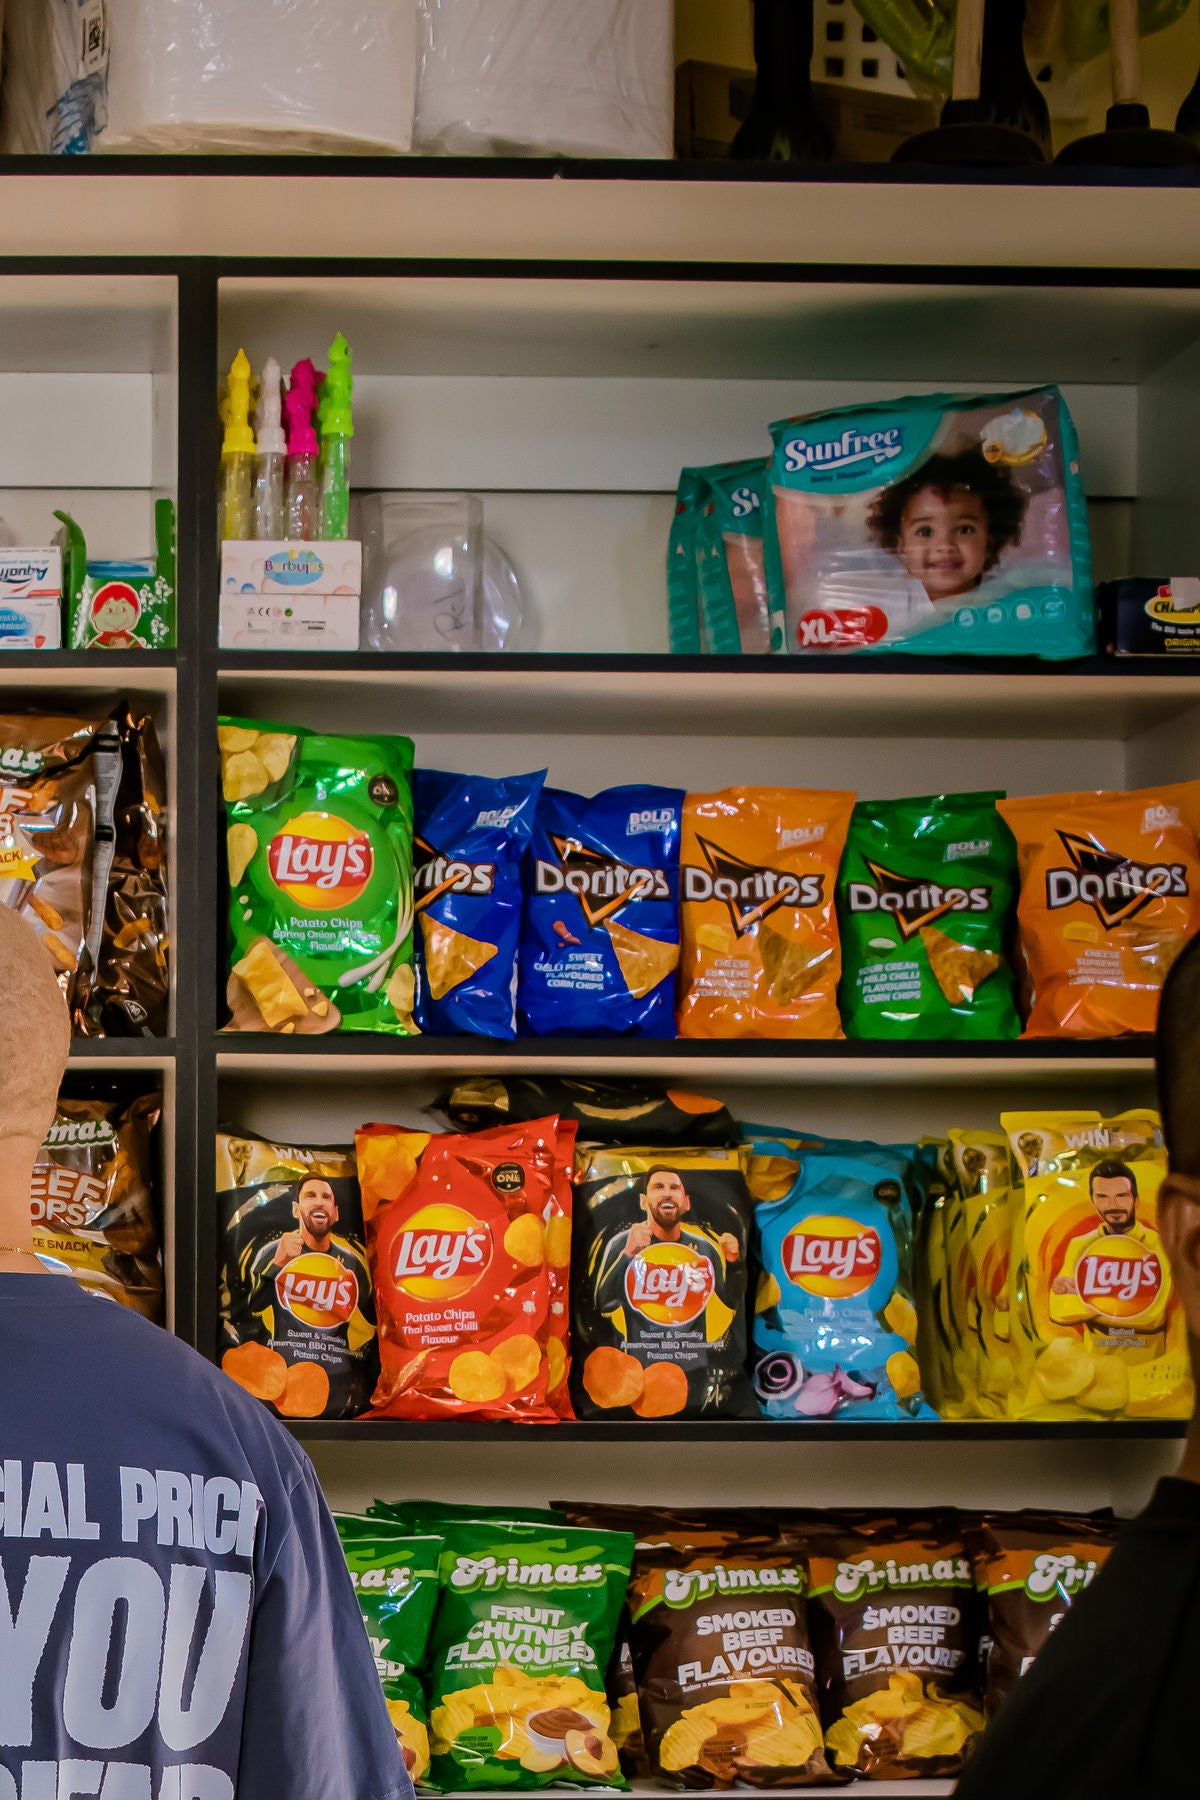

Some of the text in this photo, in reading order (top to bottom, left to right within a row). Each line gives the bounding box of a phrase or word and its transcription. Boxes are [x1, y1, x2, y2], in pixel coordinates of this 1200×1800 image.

[784, 426, 904, 472] Sunfree
[799, 617, 832, 647] XL
[629, 809, 674, 825] BOLD
[275, 834, 368, 890] Lay's
[536, 859, 670, 898] Doritos
[684, 866, 821, 905] Doritos
[1050, 864, 1188, 907] Doritos
[850, 883, 989, 911] Doritos
[290, 916, 364, 930] Potato Chips
[568, 953, 603, 962] SWEET
[1064, 1129, 1110, 1148] WIN
[47, 1239, 91, 1252] SNACK
[394, 1227, 486, 1280] Lay's
[790, 1231, 877, 1280] Lay's
[632, 1257, 708, 1307] Lay's
[1082, 1255, 1160, 1301] Lay's
[285, 1272, 353, 1312] Lay's
[402, 1320, 479, 1335] Thai Sweet Chilli
[405, 1309, 476, 1323] Potato Chips
[421, 1333, 459, 1346] Flavour
[620, 1340, 661, 1350] American
[640, 1330, 662, 1340] Sweet
[673, 1330, 704, 1342] Smoky
[647, 1350, 699, 1362] Potato Chips
[450, 1555, 604, 1588] Frimax
[664, 1564, 801, 1602] Frimax
[834, 1557, 971, 1595] Frimax
[490, 1604, 566, 1626] FRUIT
[696, 1608, 796, 1636] SMOKED
[862, 1605, 960, 1631] SMOKED
[466, 1621, 589, 1646] CHUTNEY
[722, 1628, 784, 1652] BEEF
[887, 1624, 945, 1645] BEEF
[446, 1640, 596, 1666] FLAVOURED
[677, 1647, 814, 1686] FLAVOURED
